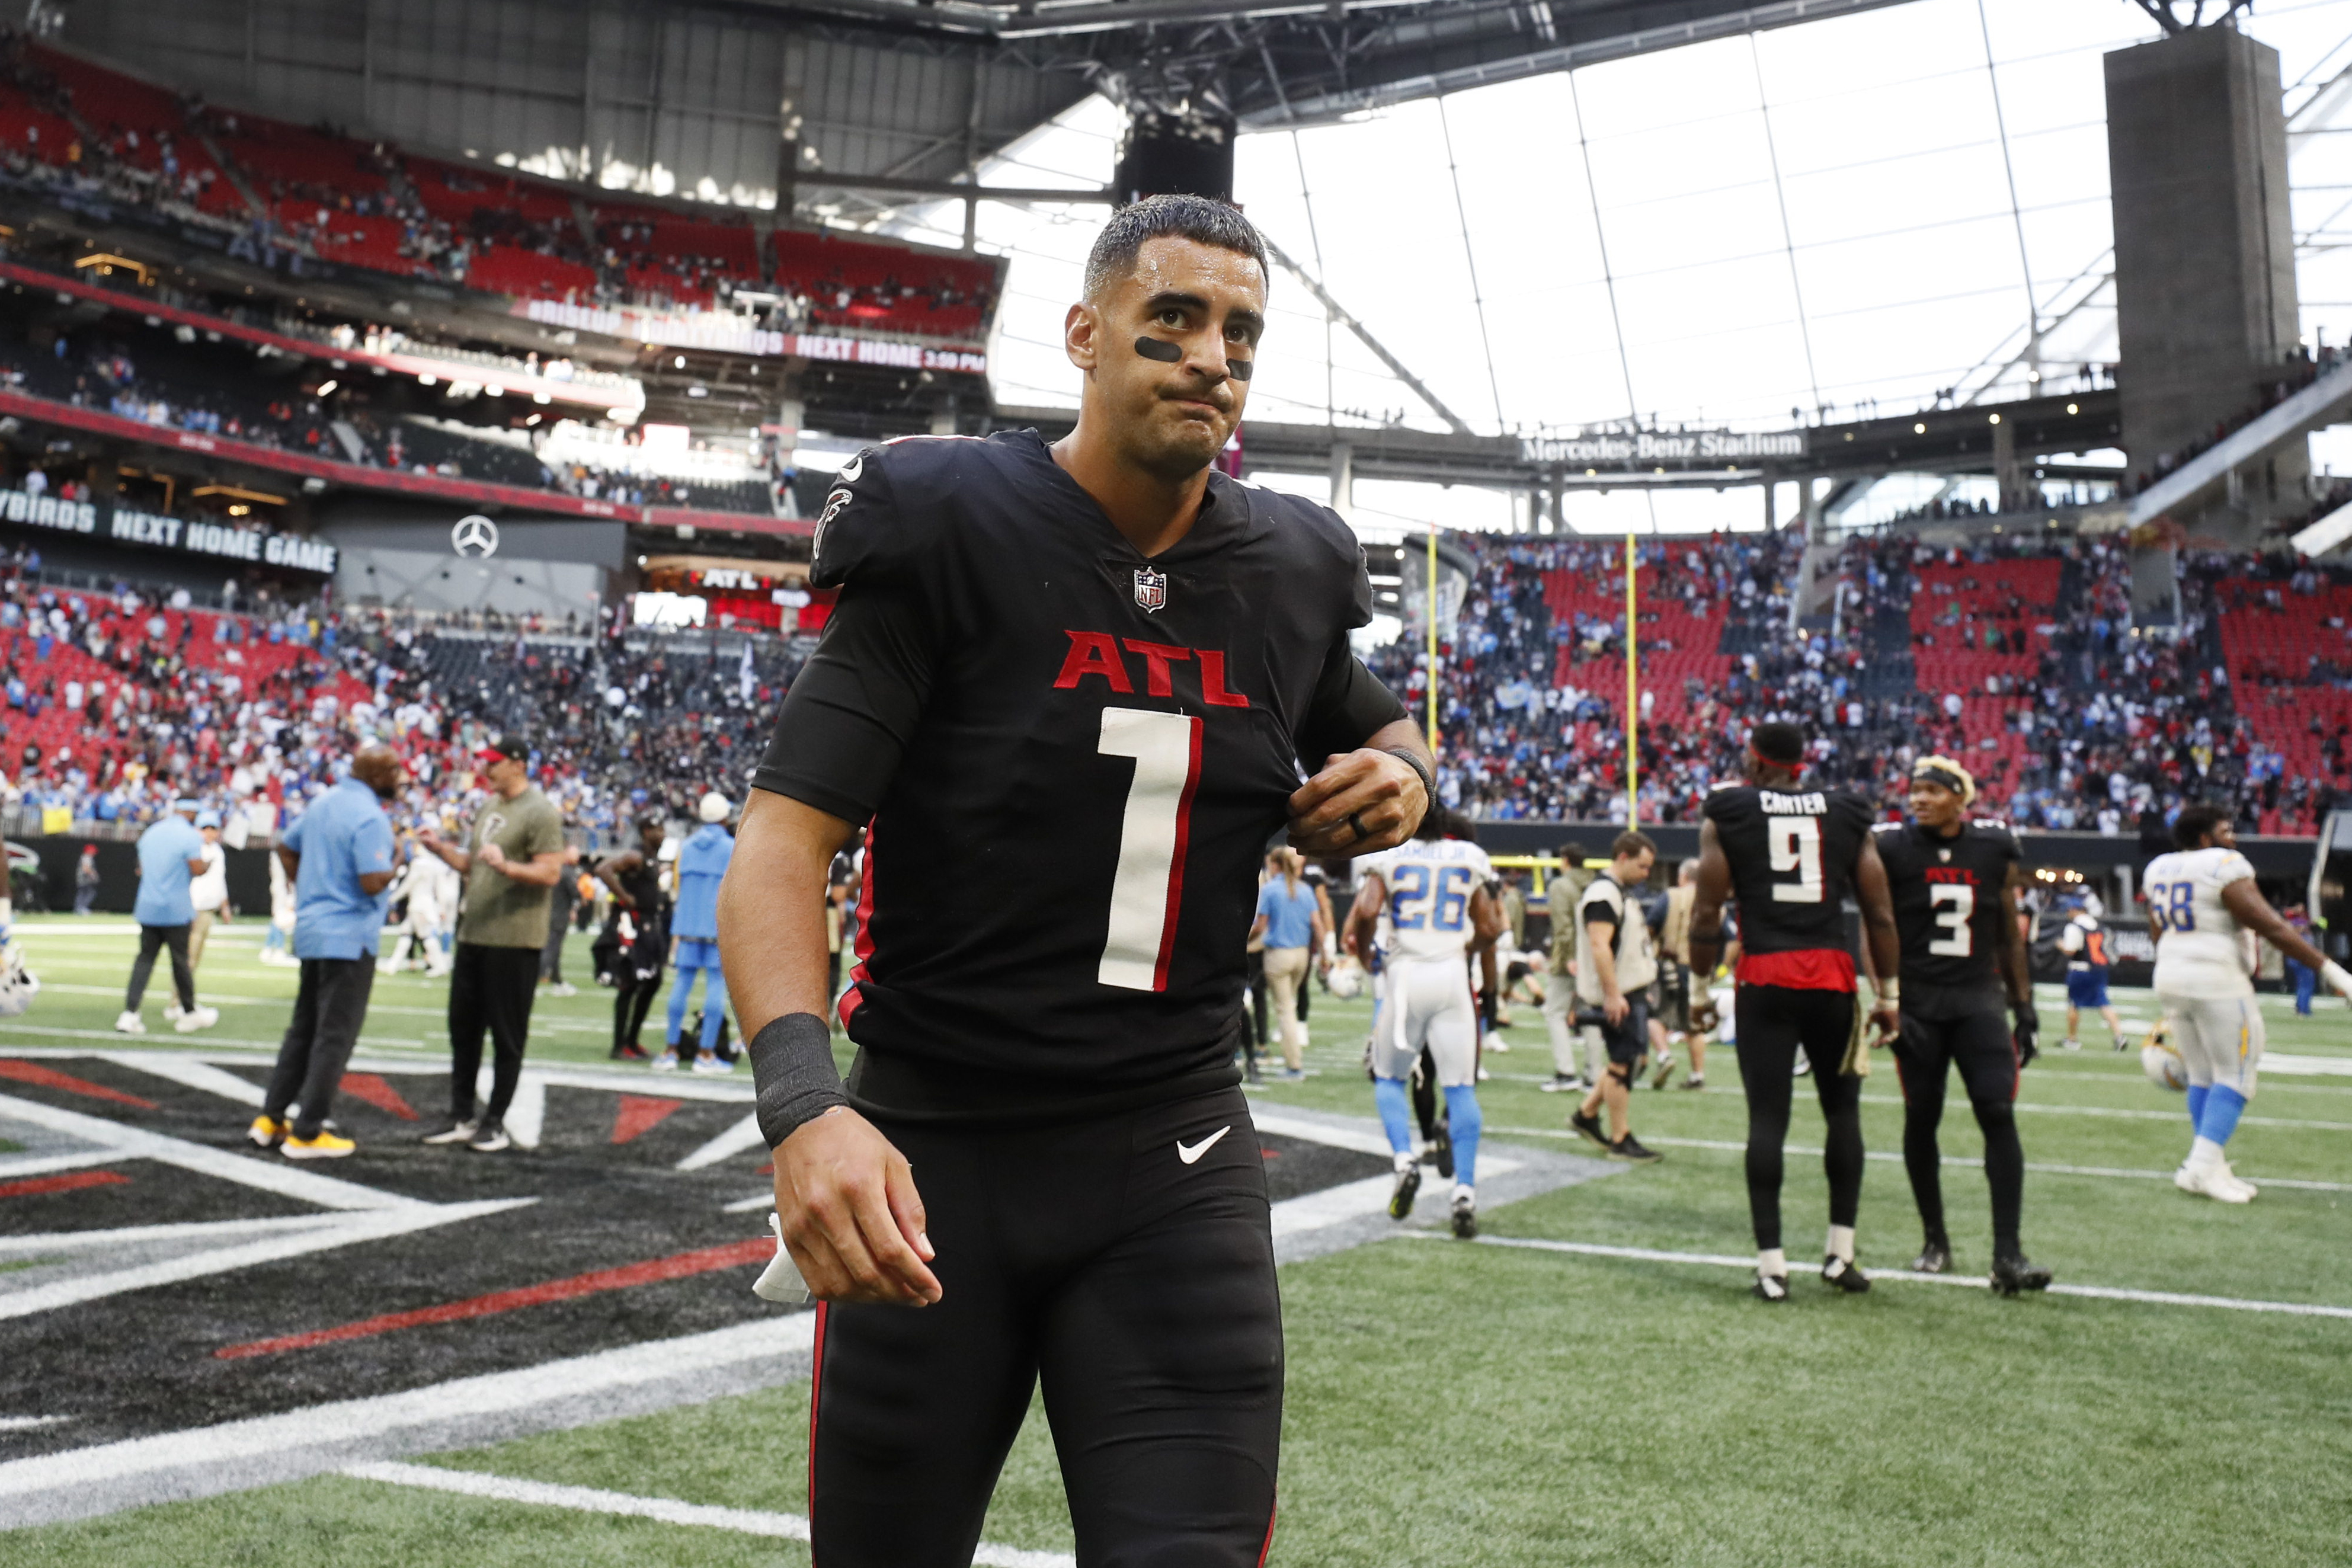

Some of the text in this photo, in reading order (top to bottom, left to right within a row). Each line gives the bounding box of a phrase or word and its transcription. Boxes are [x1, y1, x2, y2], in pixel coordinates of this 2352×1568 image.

[796, 334, 855, 361] NEXT
[858, 340, 921, 369] HOME
[960, 353, 985, 370] PM
[1522, 432, 1802, 460] Mercedes-Benz Stadium
[112, 509, 181, 547] NEXT
[186, 521, 261, 561] HOME
[265, 535, 336, 574] GAME
[703, 568, 758, 589] ATL
[1140, 587, 1162, 604] NFL
[1053, 630, 1250, 707] ATL
[1759, 790, 1828, 815] CARTER
[1097, 706, 1204, 992] 1
[1768, 815, 1826, 903] 9
[1393, 864, 1471, 932] 26
[1924, 867, 1982, 885] ATL
[1928, 883, 1977, 958] 3
[2151, 882, 2196, 932] 68
